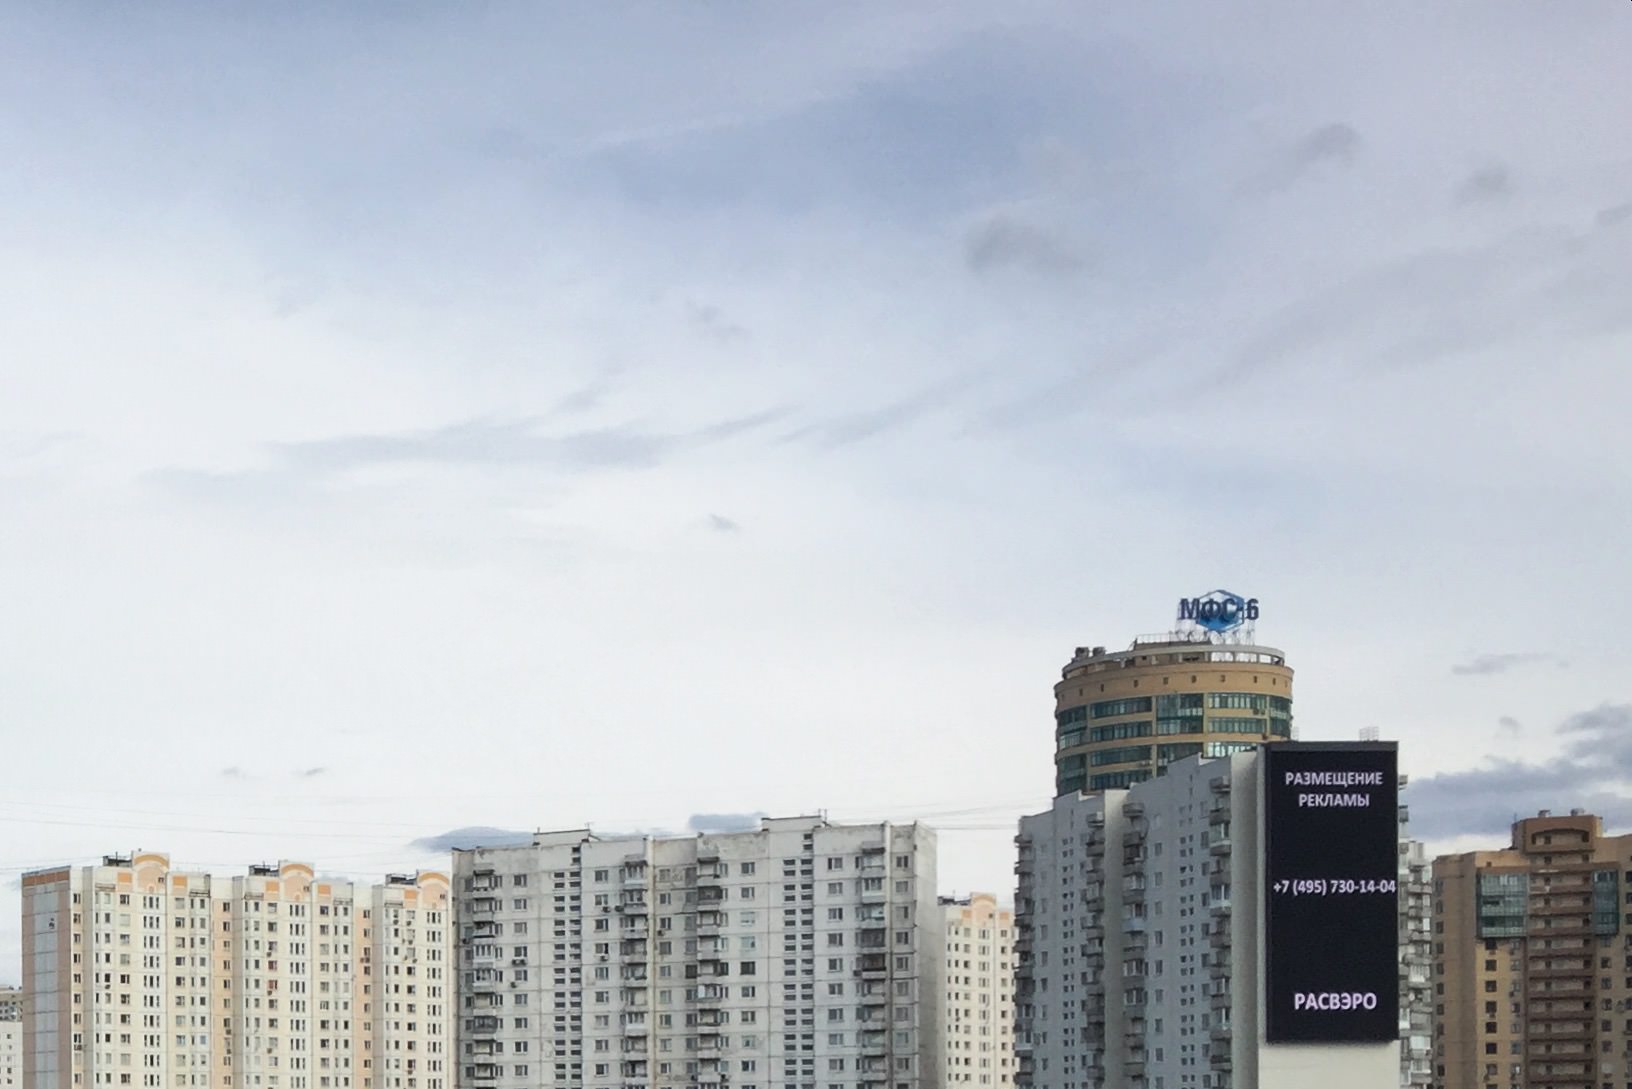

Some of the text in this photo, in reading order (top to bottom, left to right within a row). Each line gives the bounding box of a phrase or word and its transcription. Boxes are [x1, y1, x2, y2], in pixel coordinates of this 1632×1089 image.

[1179, 598, 1259, 620] МФС-6
[1285, 771, 1383, 787] РАЗМЕЩЕНИЕ
[1298, 793, 1370, 807] РЕКЛАМЫ
[1273, 879, 1396, 896] +7 (495) 730-14-04
[1294, 992, 1377, 1010] РАСВЭРО
